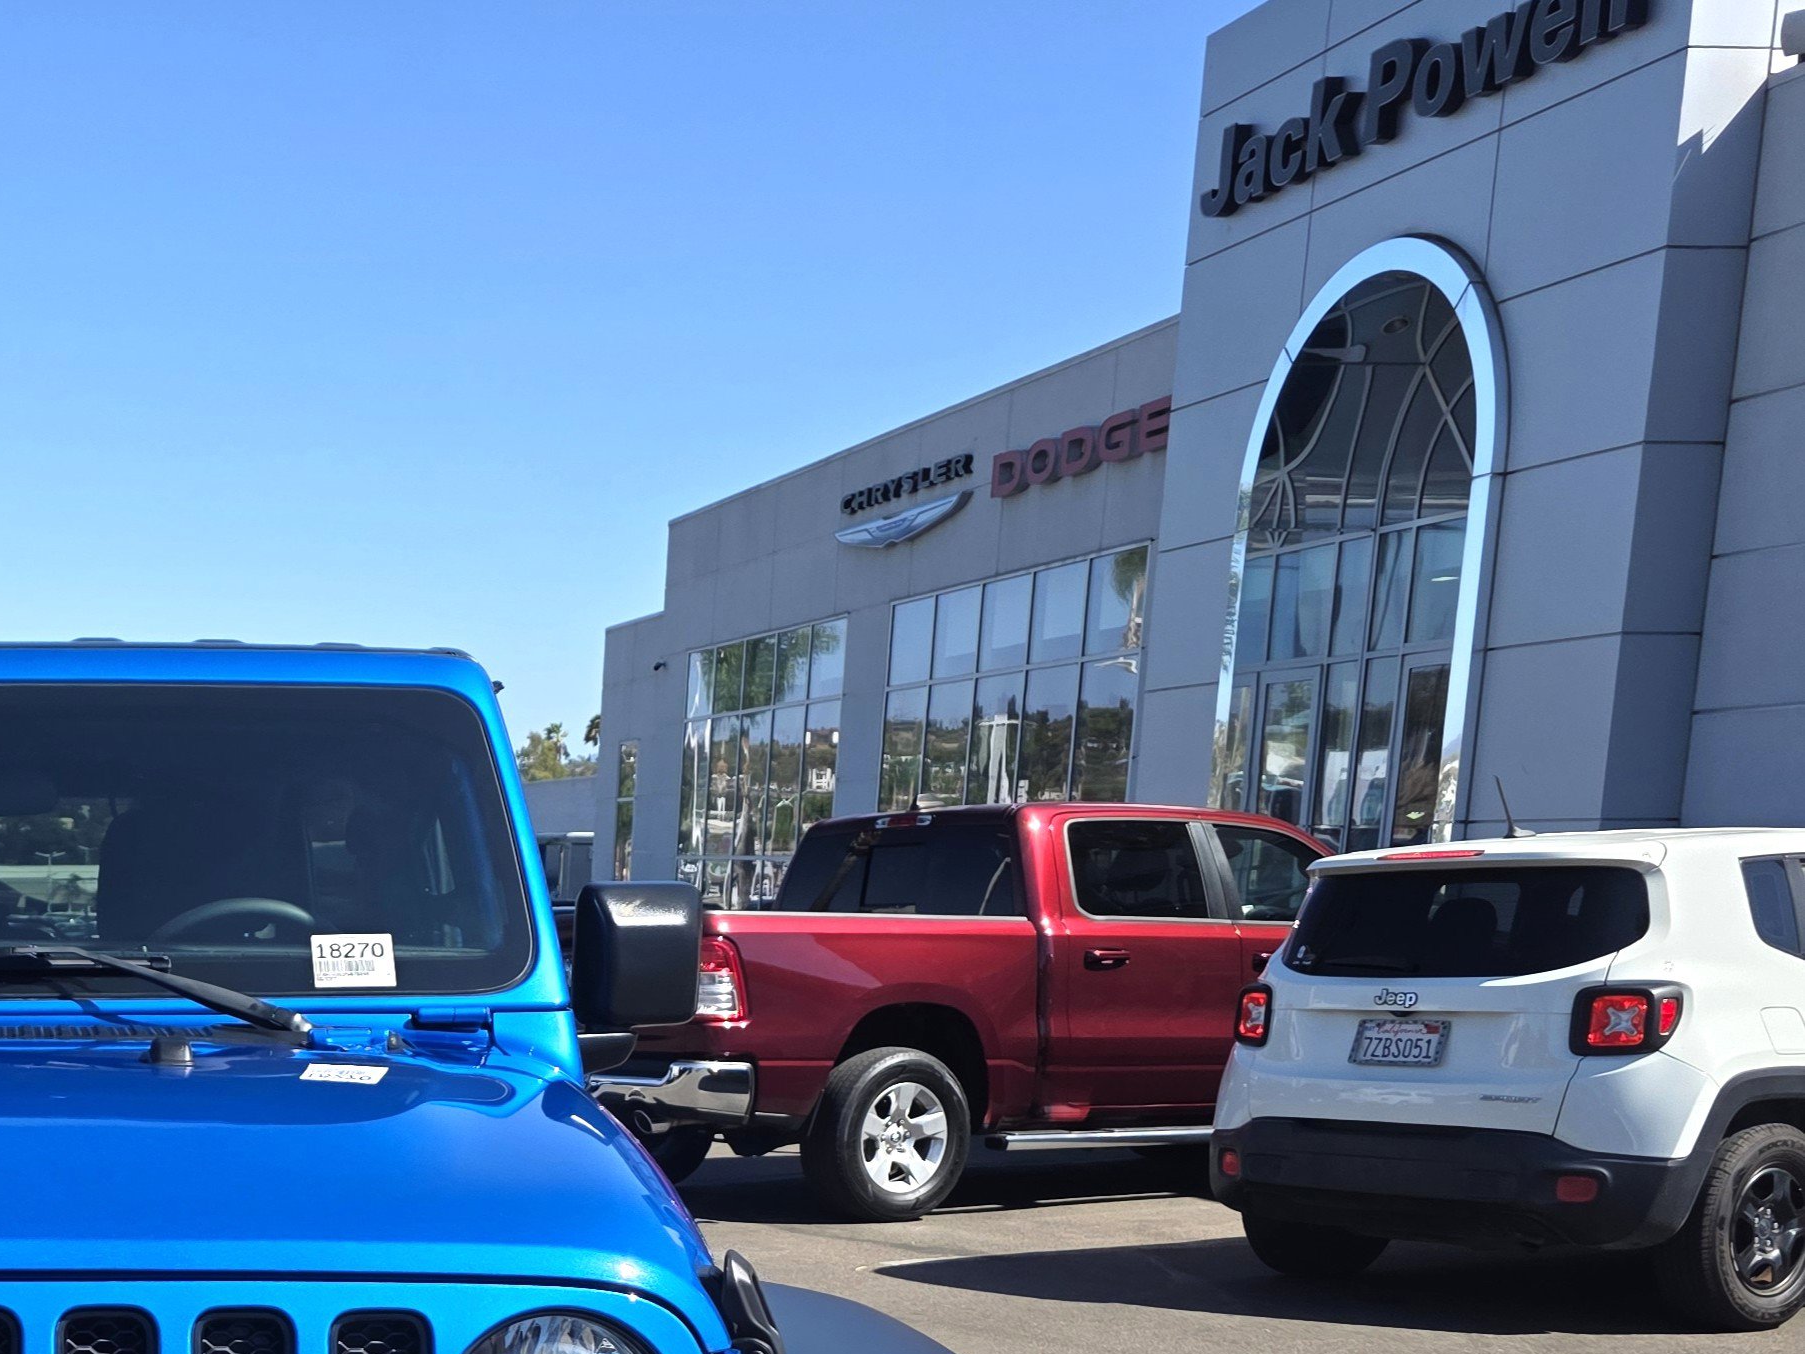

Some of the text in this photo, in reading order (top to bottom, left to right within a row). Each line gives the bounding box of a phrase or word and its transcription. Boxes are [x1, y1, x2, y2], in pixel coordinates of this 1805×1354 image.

[1200, 76, 1361, 217] Jack
[991, 394, 1172, 498] DODGE
[840, 453, 973, 514] CHRYSLER
[316, 942, 384, 958] 18270
[1374, 988, 1418, 1008] Jeep
[1362, 1036, 1433, 1059] 7ZBS051
